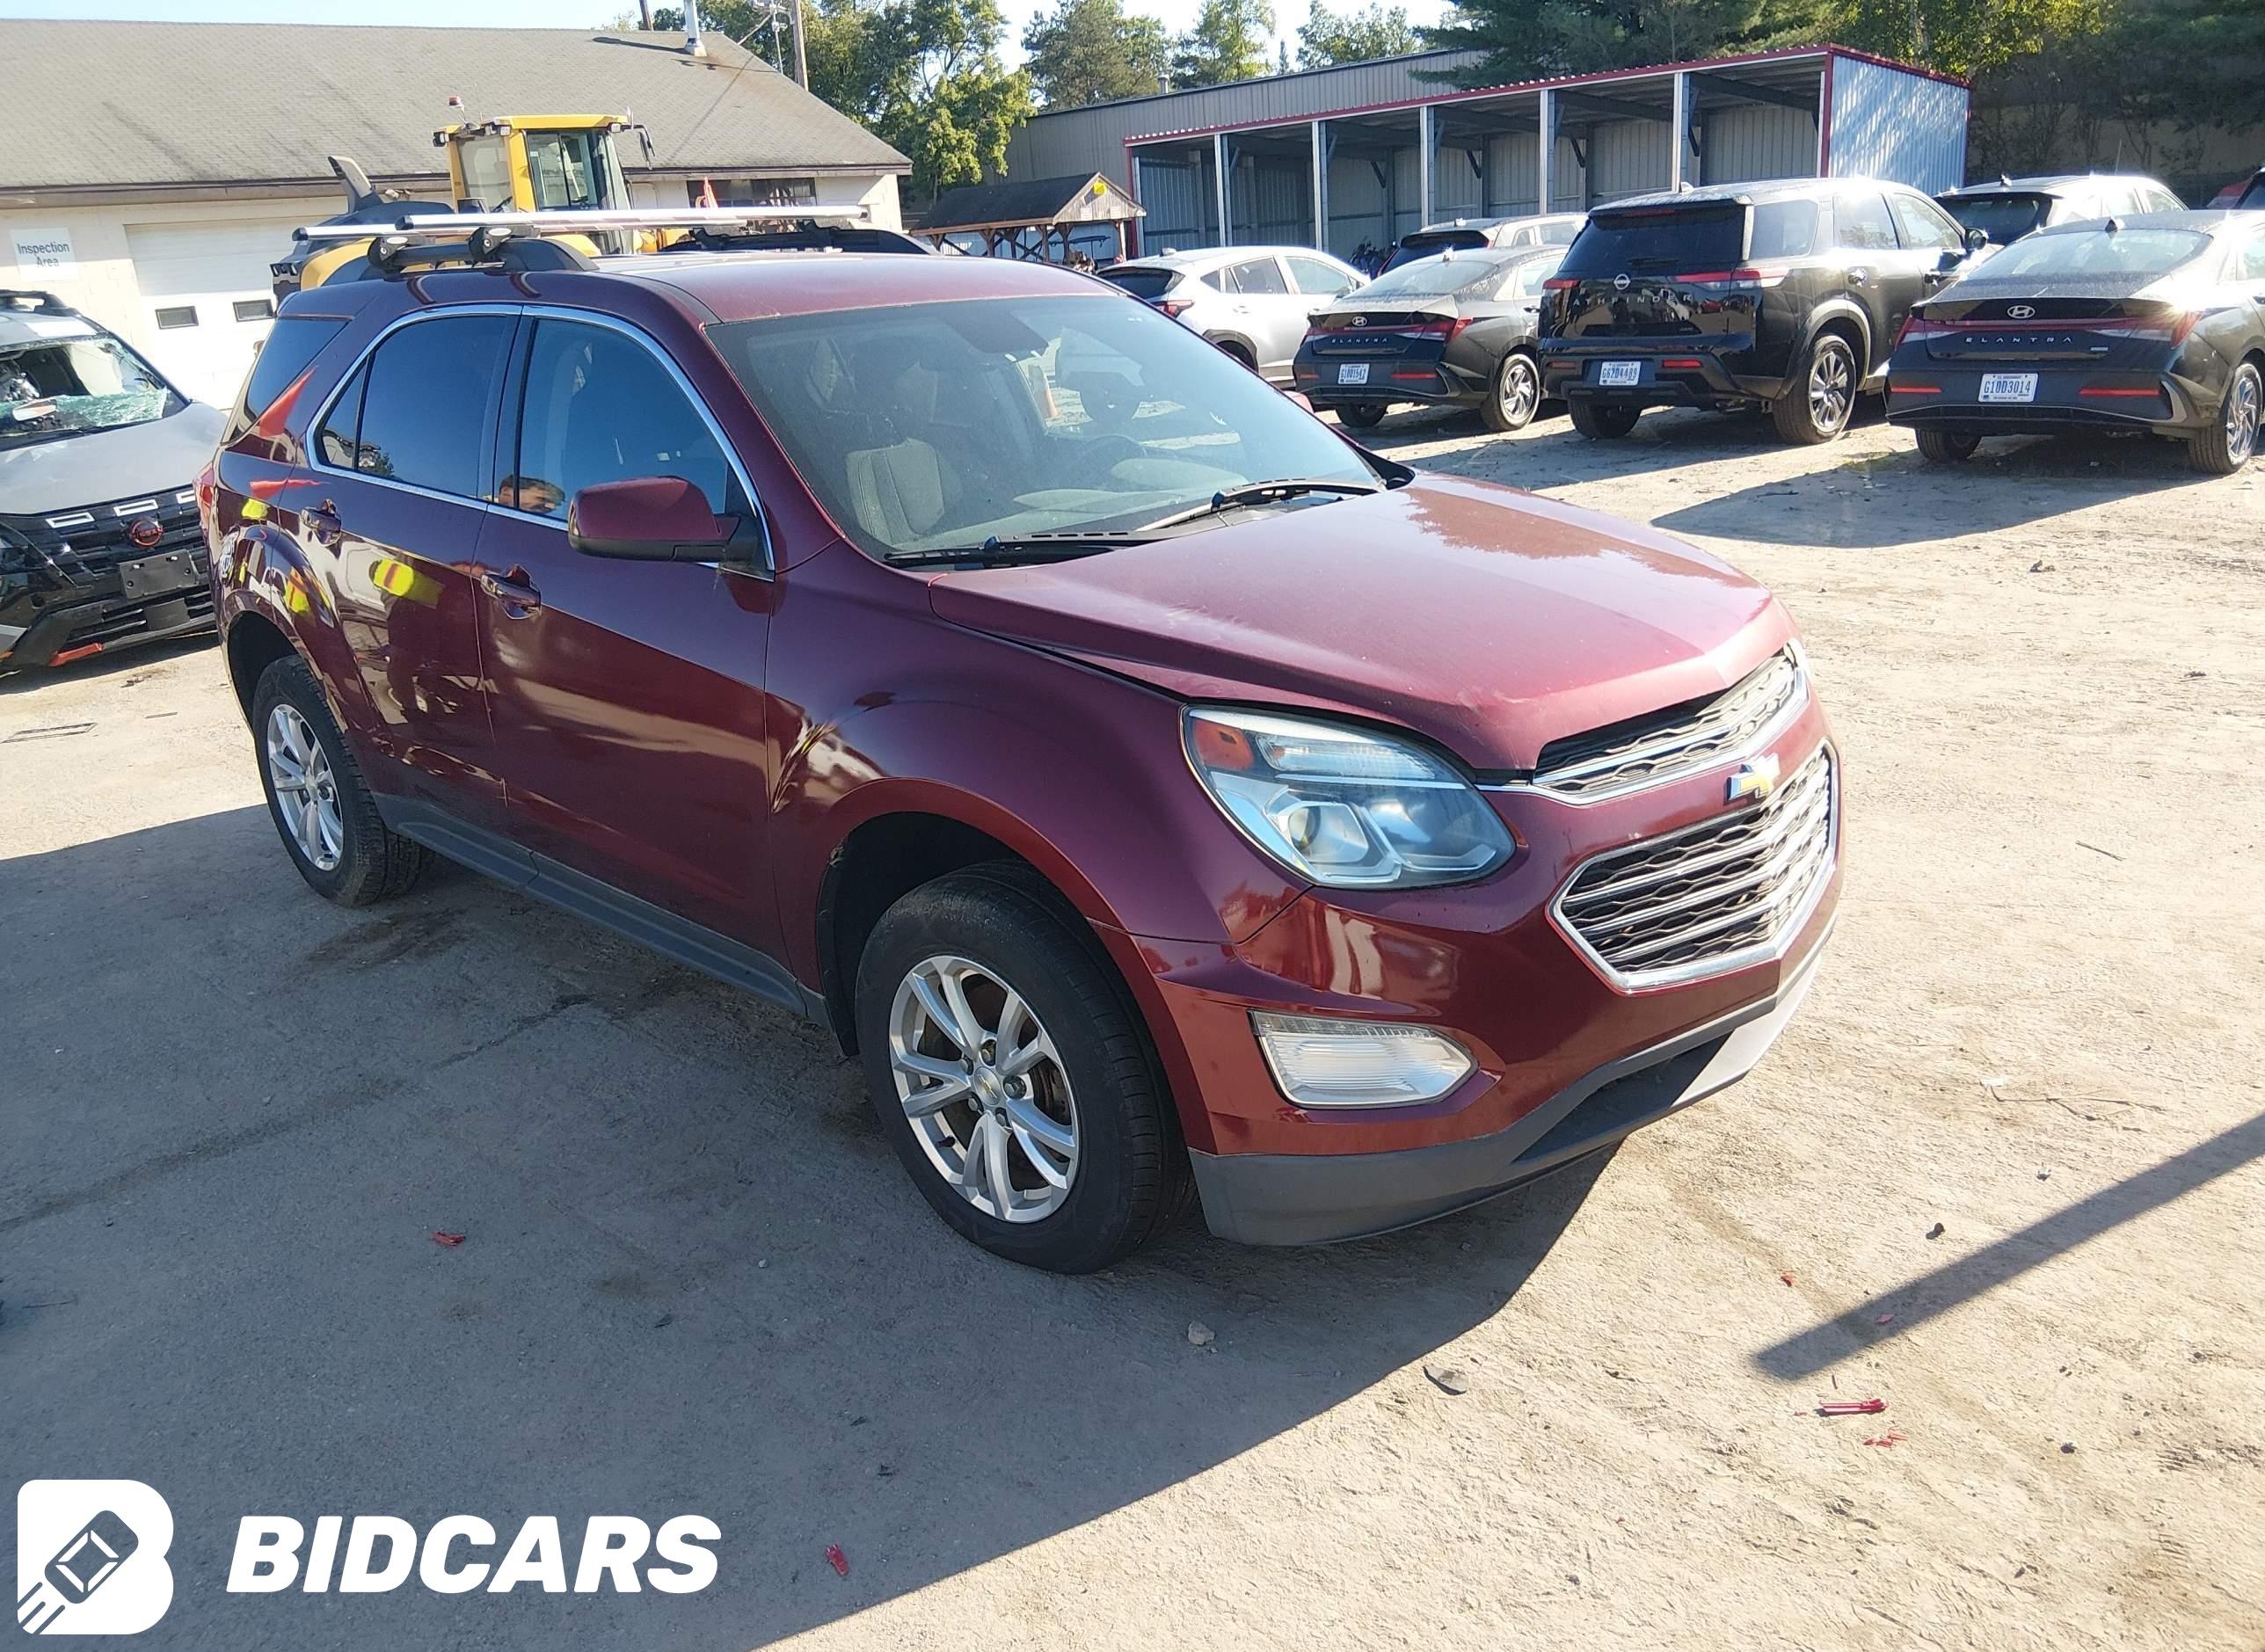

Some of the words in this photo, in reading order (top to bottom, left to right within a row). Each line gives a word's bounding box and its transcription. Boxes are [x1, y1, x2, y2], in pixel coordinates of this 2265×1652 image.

[16, 241, 70, 256] Inspection
[36, 256, 60, 267] Area
[1572, 294, 1693, 306] ATHFINDER
